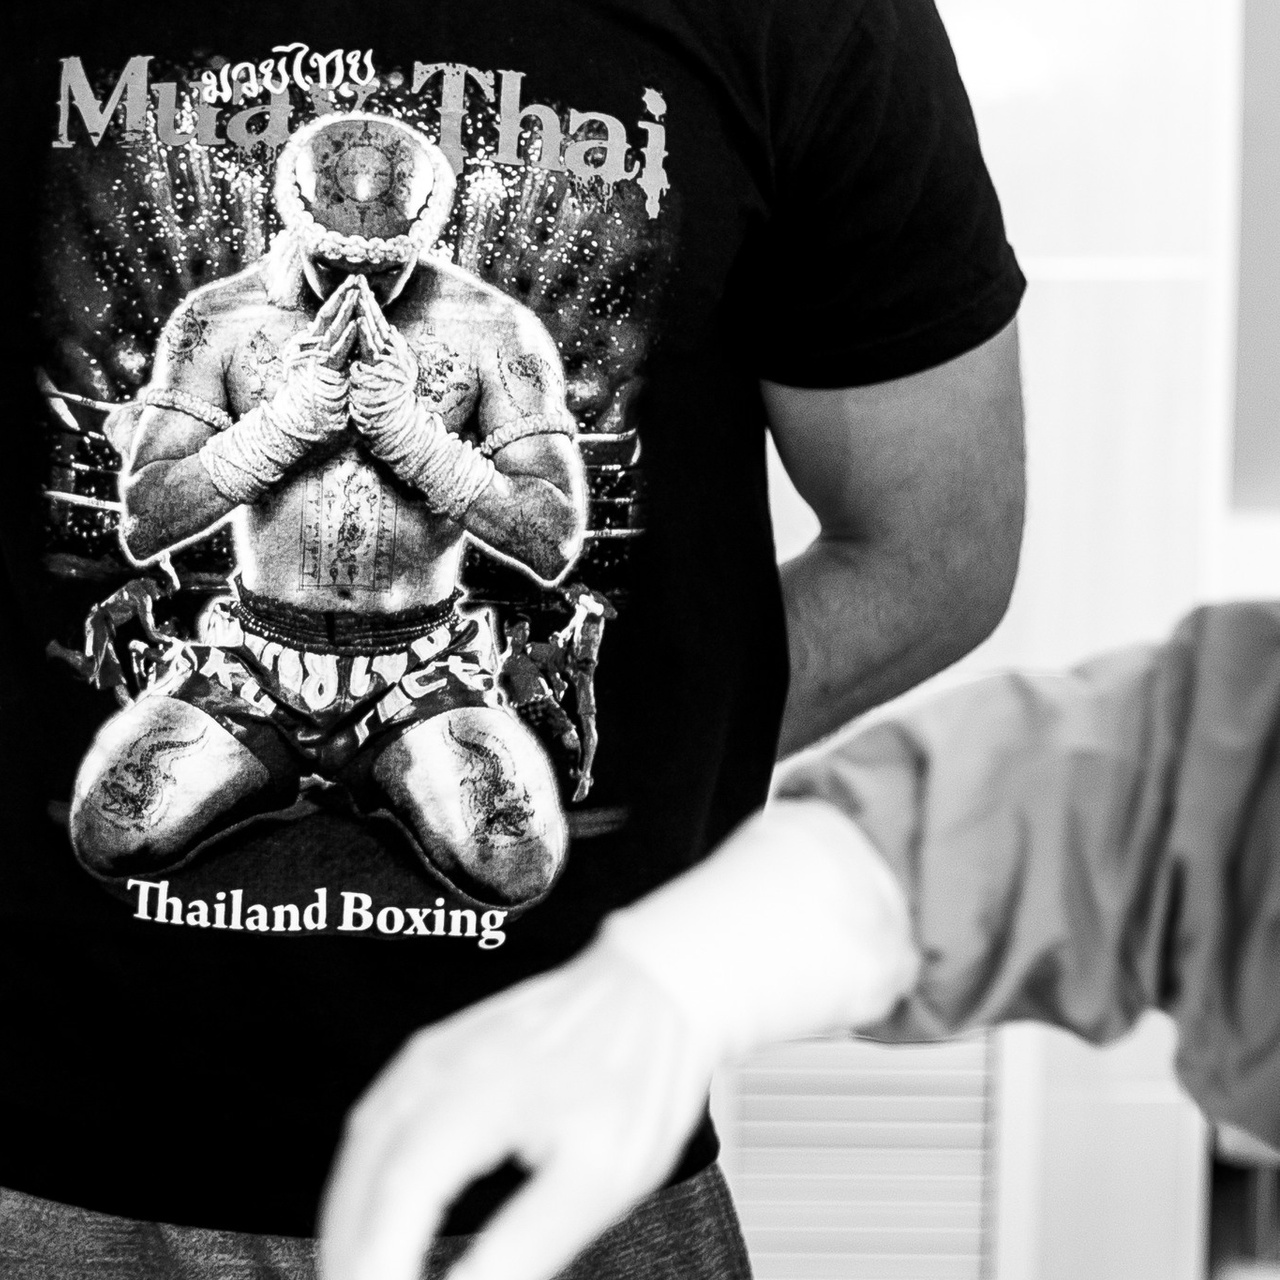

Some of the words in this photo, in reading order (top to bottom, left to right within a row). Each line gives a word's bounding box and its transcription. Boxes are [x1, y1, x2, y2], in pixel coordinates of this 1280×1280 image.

[201, 42, 376, 104] มวยไทย
[411, 61, 670, 219] Thai
[127, 878, 327, 932] Thailand
[337, 891, 508, 949] Boxing
